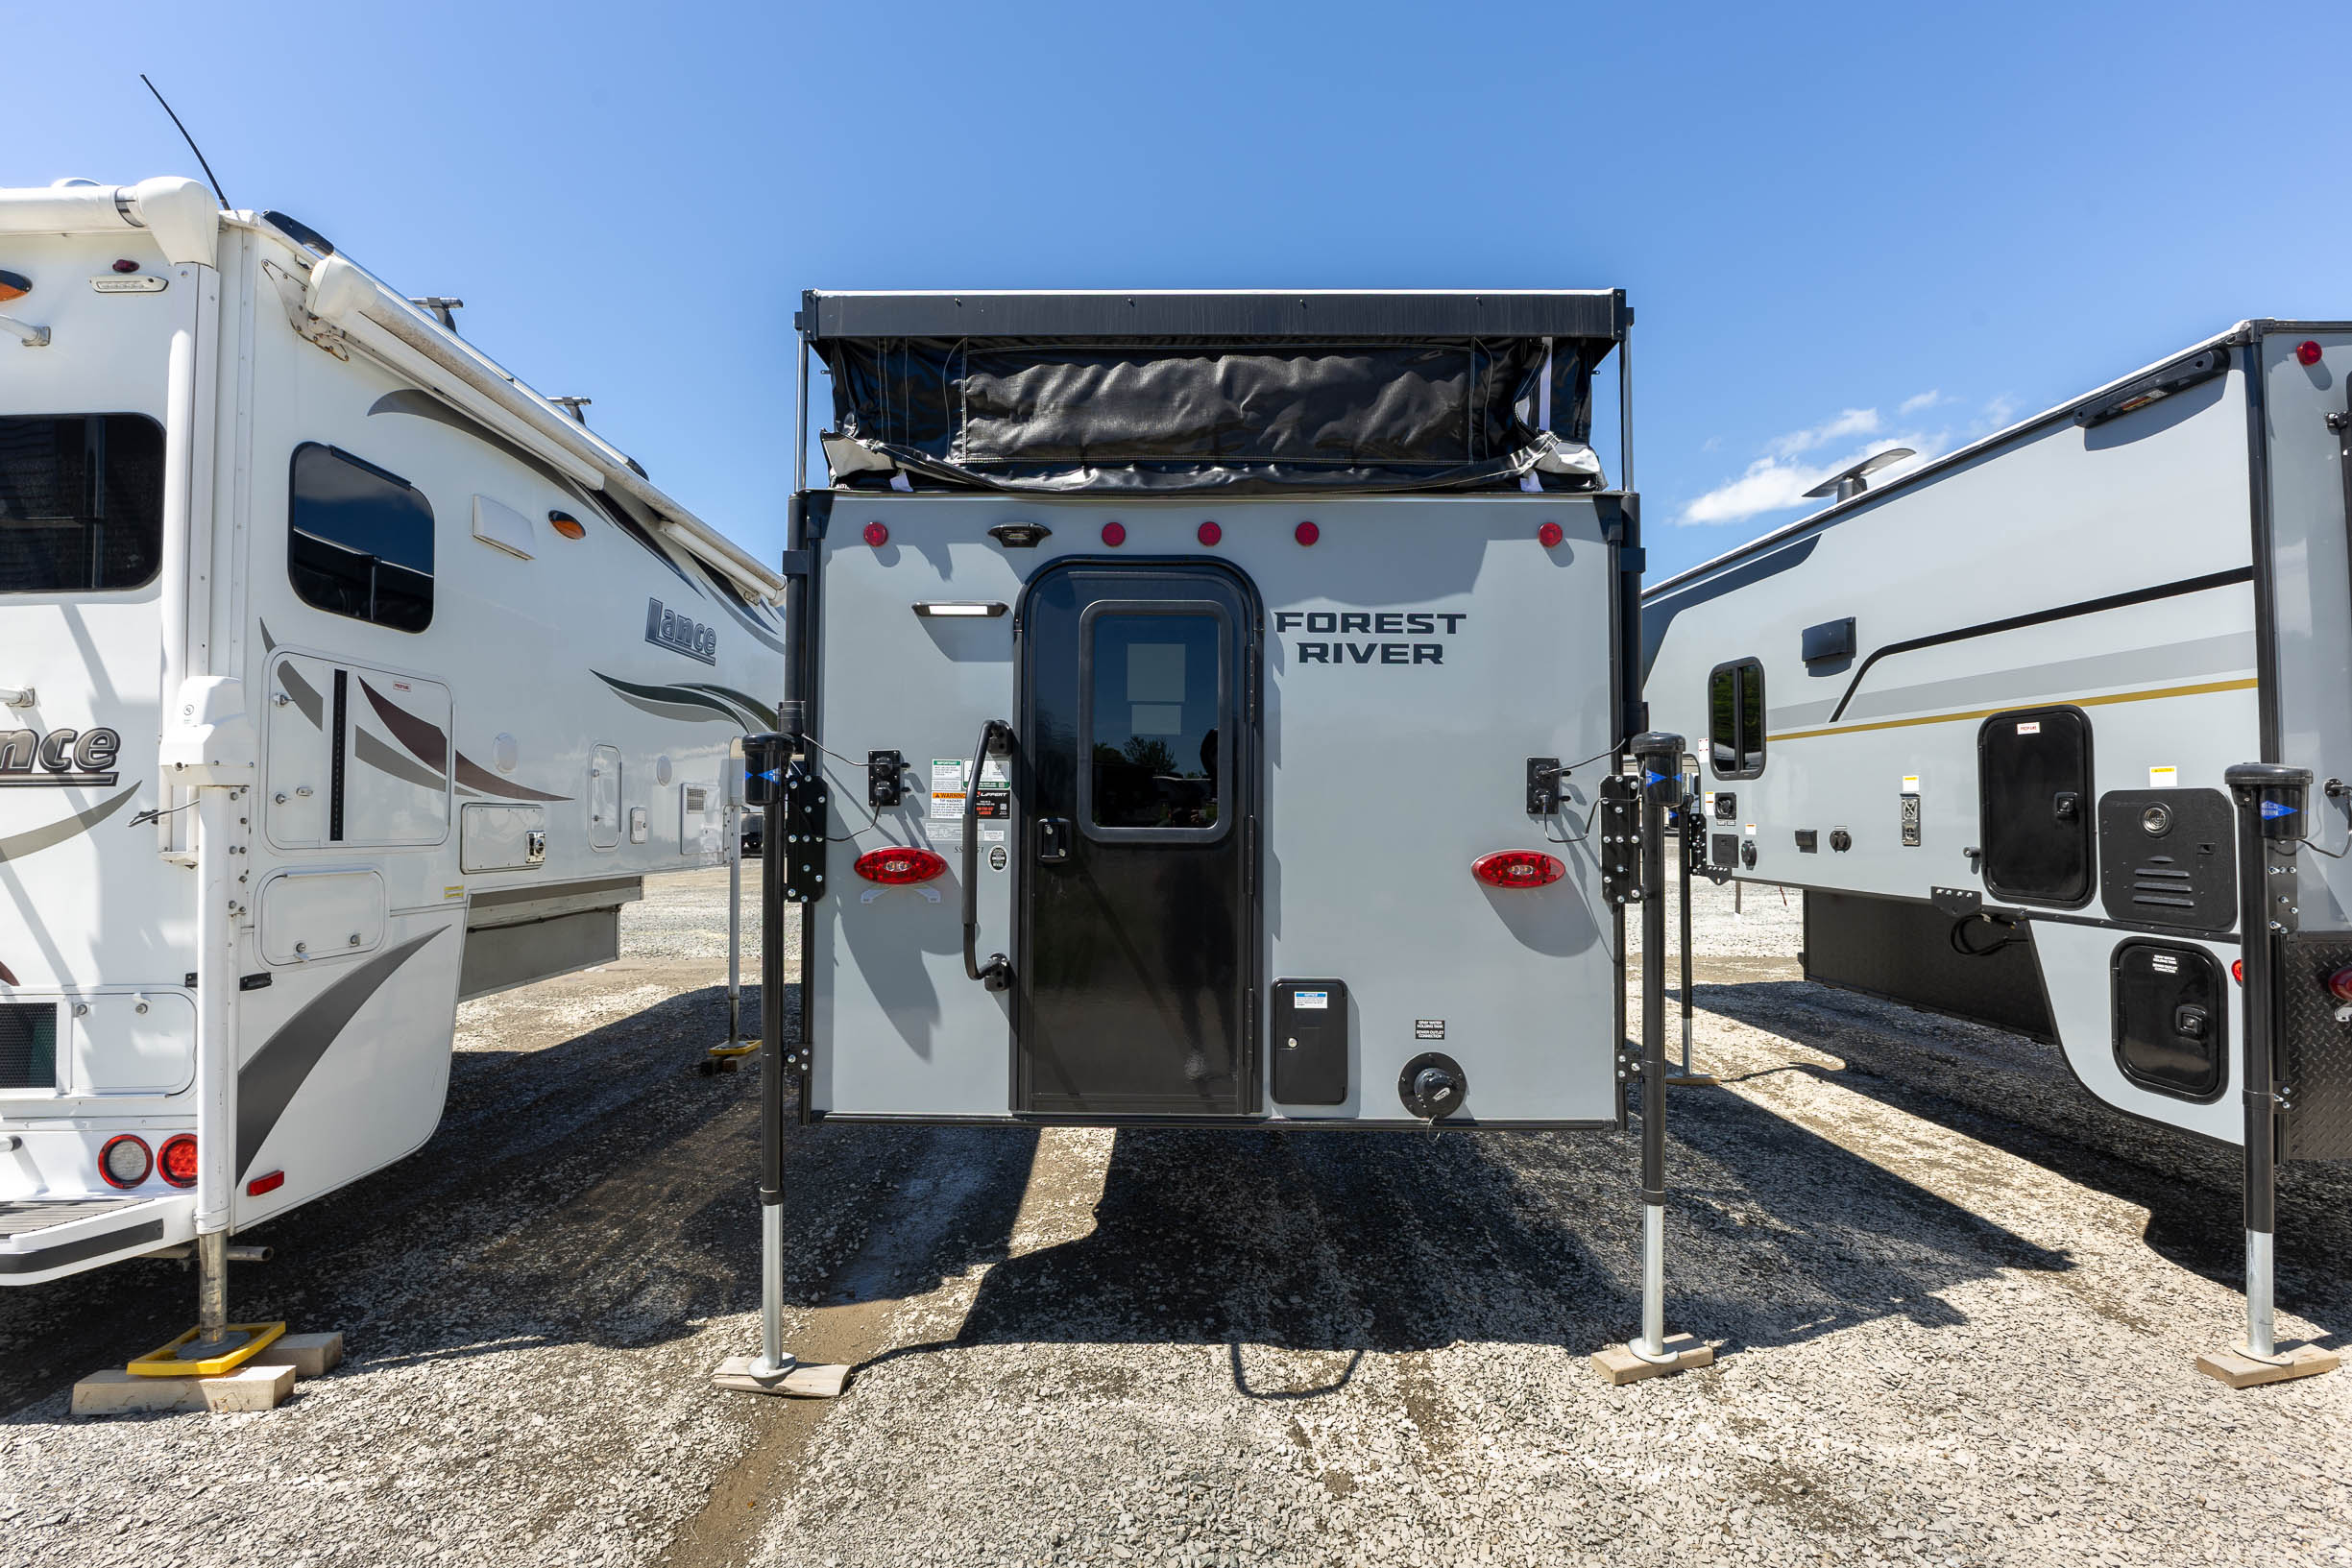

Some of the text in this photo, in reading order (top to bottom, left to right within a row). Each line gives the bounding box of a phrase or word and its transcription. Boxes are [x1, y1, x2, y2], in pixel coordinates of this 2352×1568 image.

[645, 597, 716, 666] Lance
[1273, 612, 1467, 635] FOREST
[1296, 642, 1444, 664] RIVER
